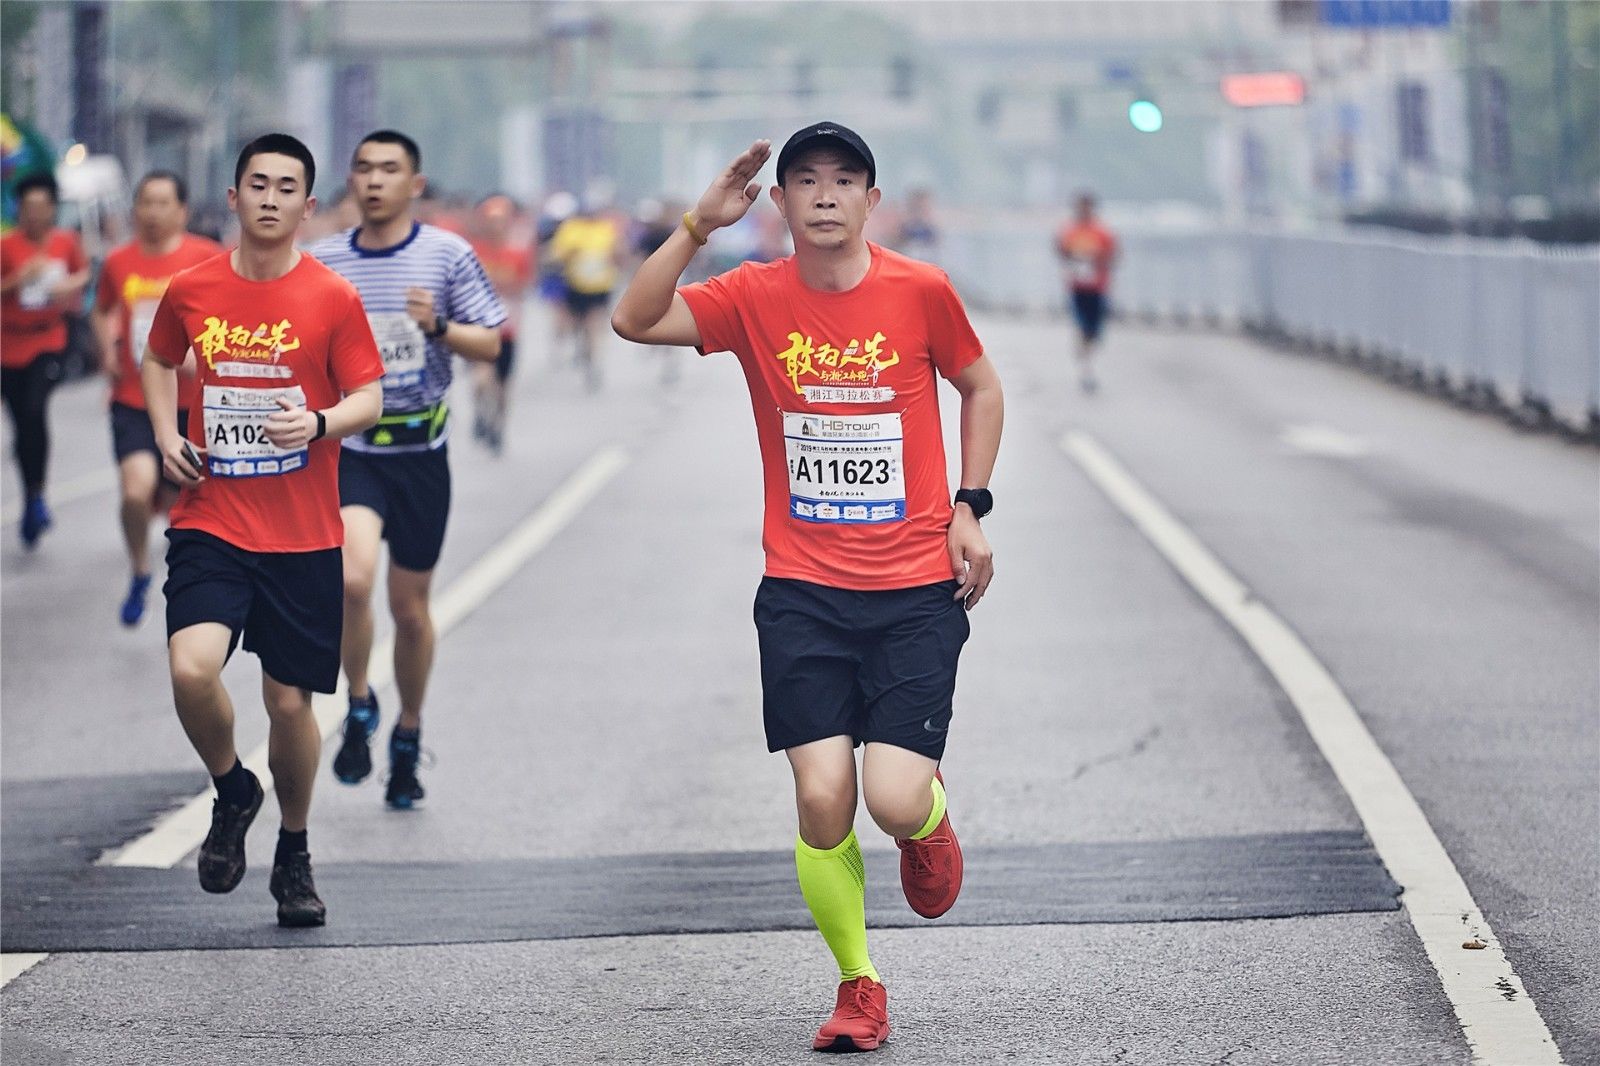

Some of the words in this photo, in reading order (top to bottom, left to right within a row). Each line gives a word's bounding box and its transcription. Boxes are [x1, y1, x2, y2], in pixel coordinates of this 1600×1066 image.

[194, 316, 300, 370] 敢为人先
[776, 331, 900, 395] 敢为人先
[810, 389, 882, 401] 湘江马拉松赛
[214, 423, 270, 445] A102
[796, 456, 890, 485] A11623
